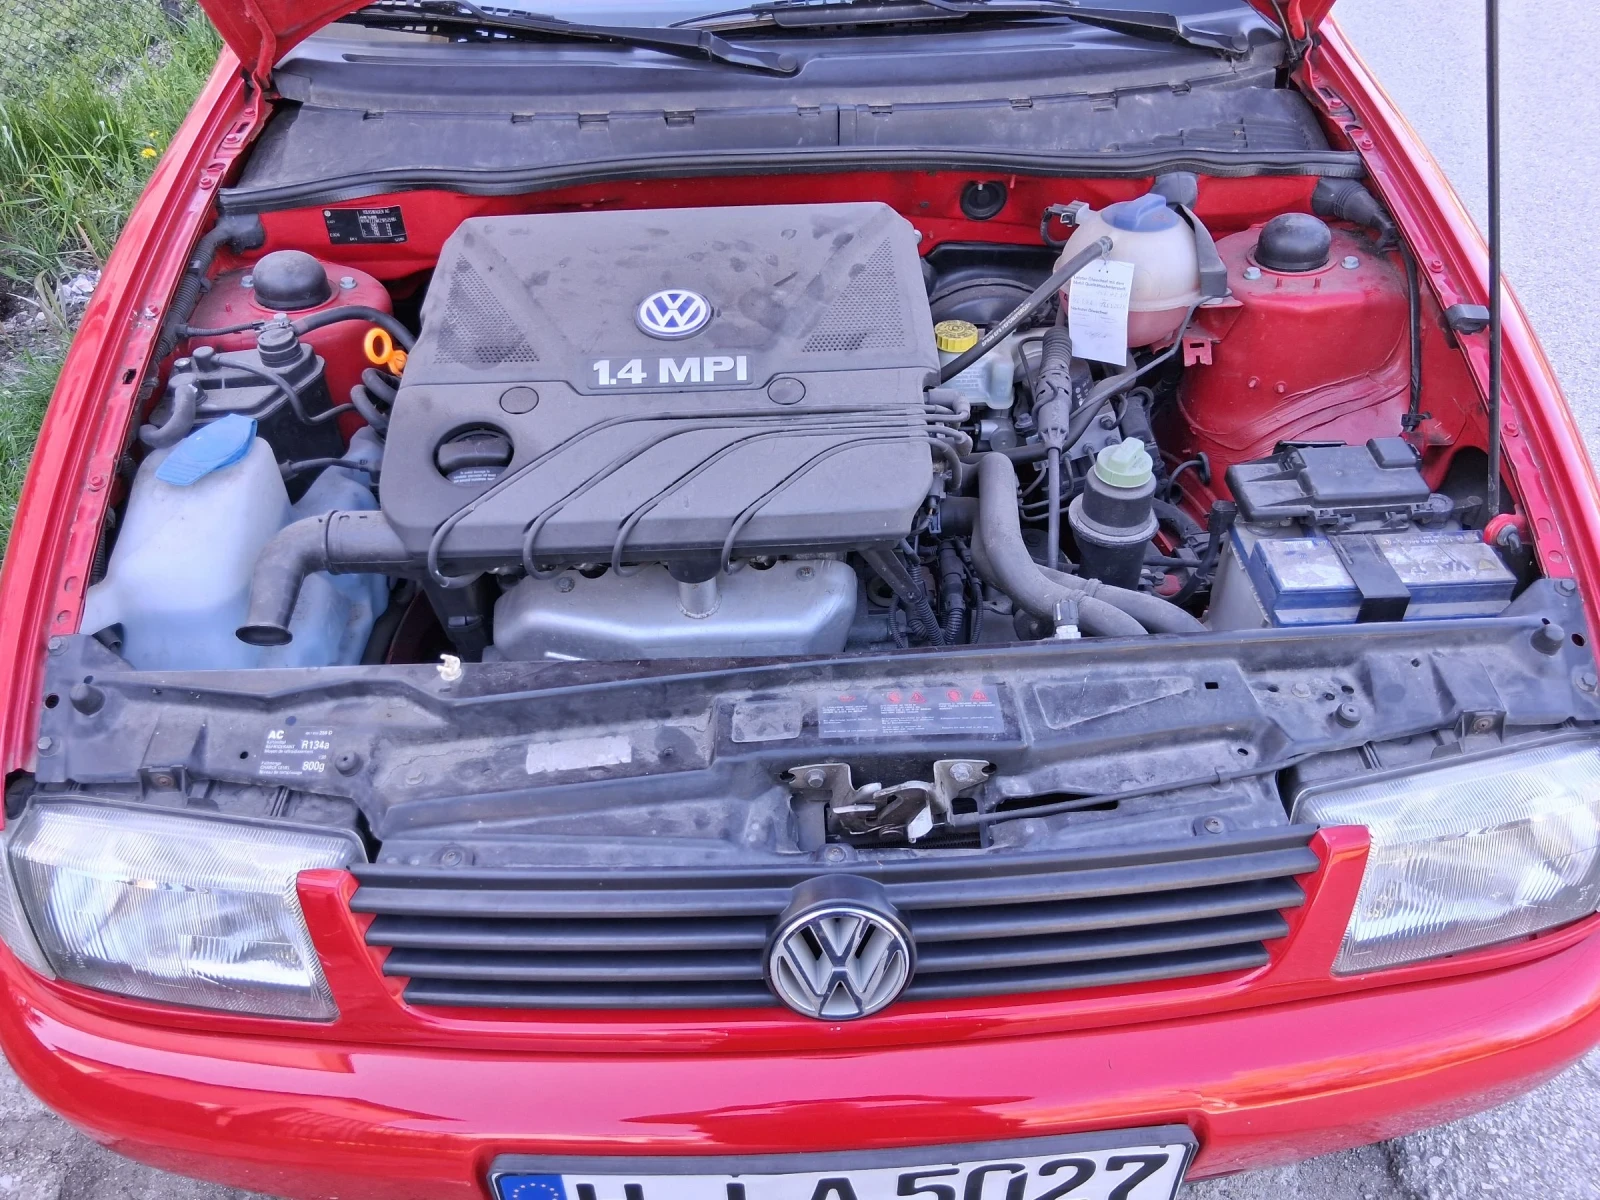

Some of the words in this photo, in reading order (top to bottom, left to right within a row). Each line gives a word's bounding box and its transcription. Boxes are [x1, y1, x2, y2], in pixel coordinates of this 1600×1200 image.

[593, 359, 647, 385] 1.4
[659, 356, 747, 384] MPI
[268, 730, 284, 740] AC
[301, 740, 330, 750] R134a
[302, 761, 325, 772] 800g
[770, 908, 910, 1020] VW
[896, 1153, 1170, 1200] 5027
